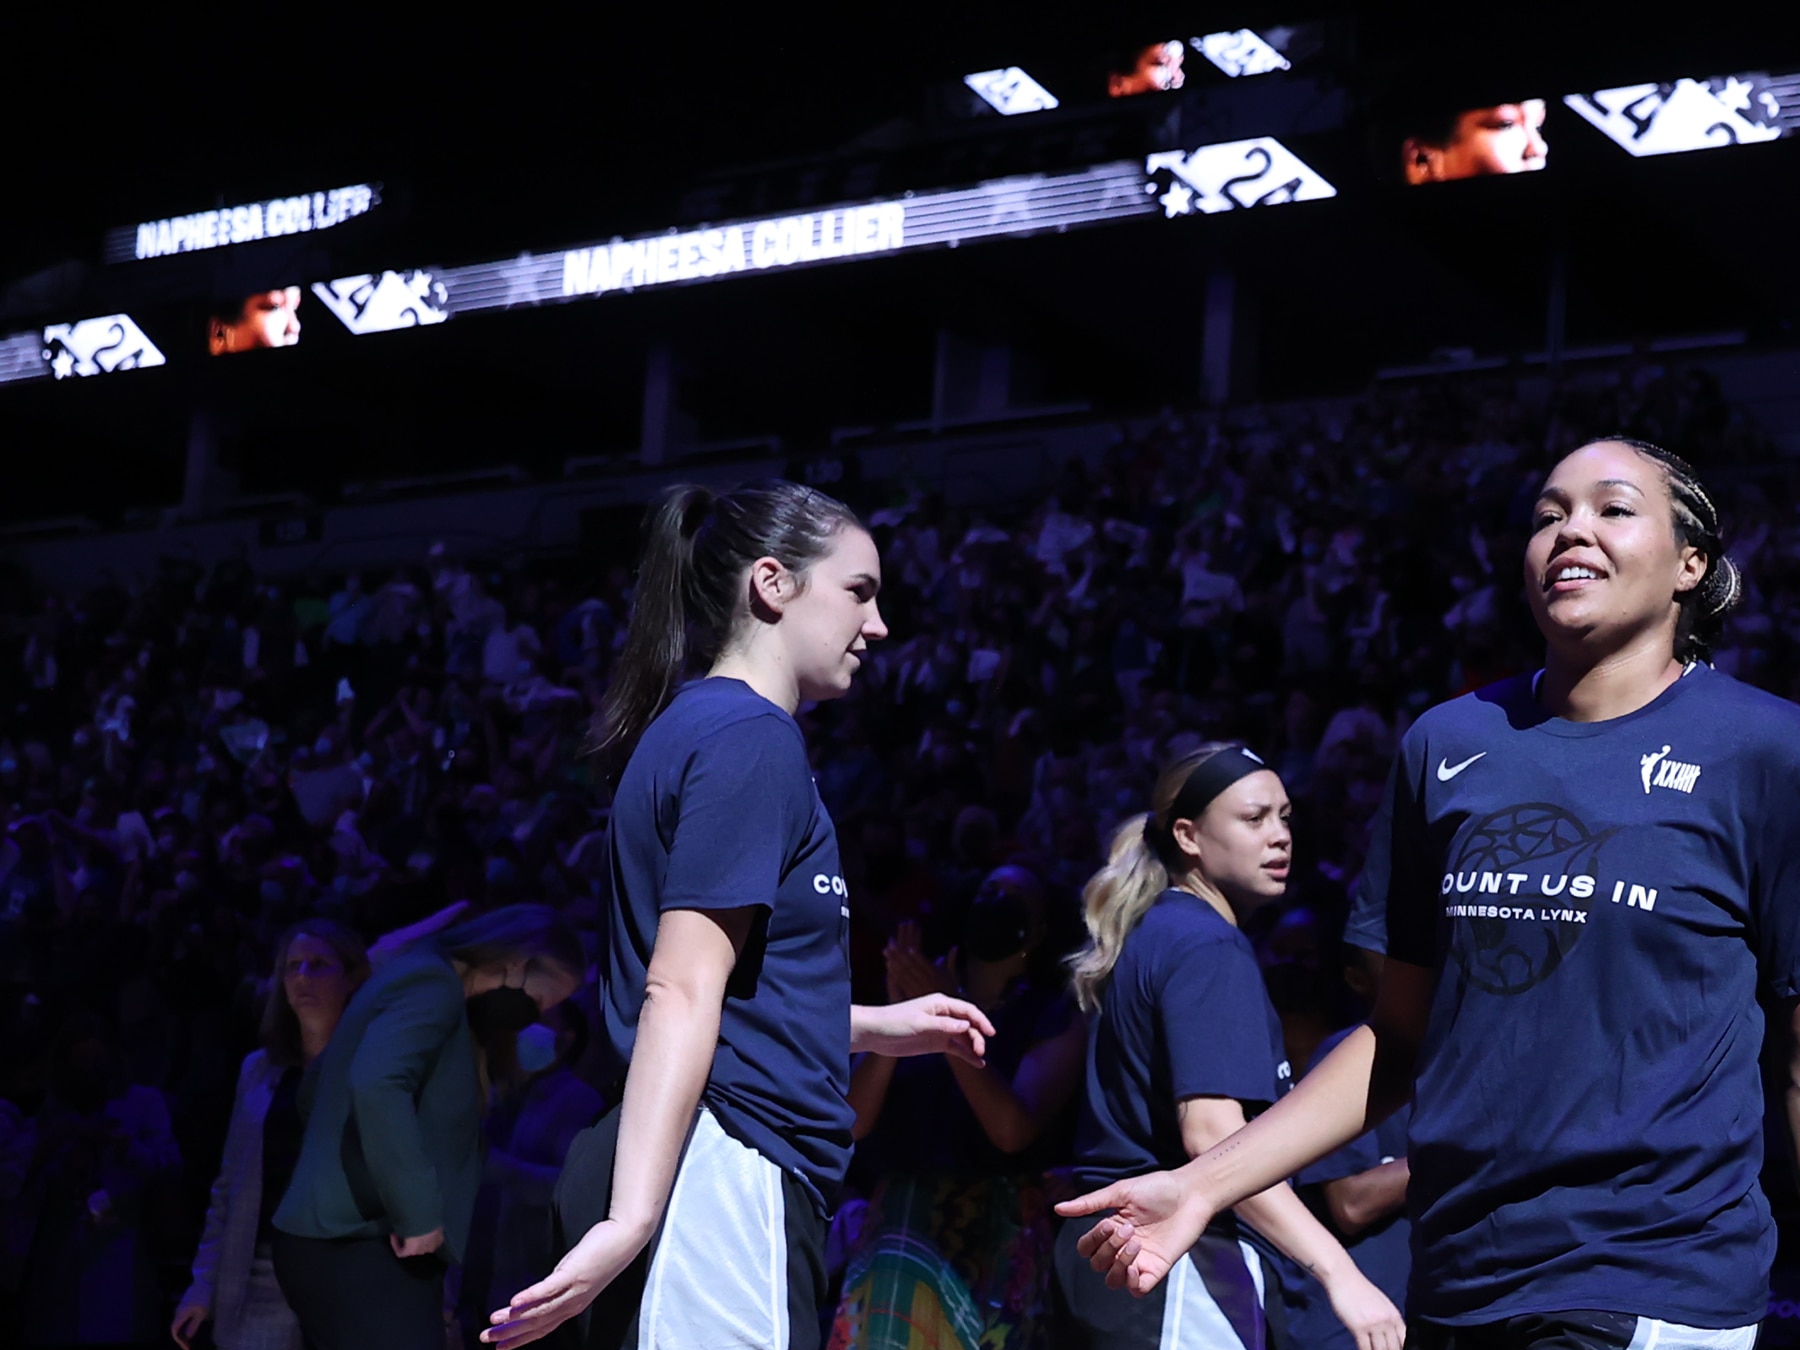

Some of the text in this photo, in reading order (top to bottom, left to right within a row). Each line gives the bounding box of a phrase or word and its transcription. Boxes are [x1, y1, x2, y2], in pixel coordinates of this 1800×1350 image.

[136, 203, 263, 260] NAPHEESA
[562, 202, 905, 297] NAPHEESA COLLIER
[1541, 874, 1597, 898] US
[1611, 880, 1659, 912] IN
[1541, 908, 1588, 924] LYNX
